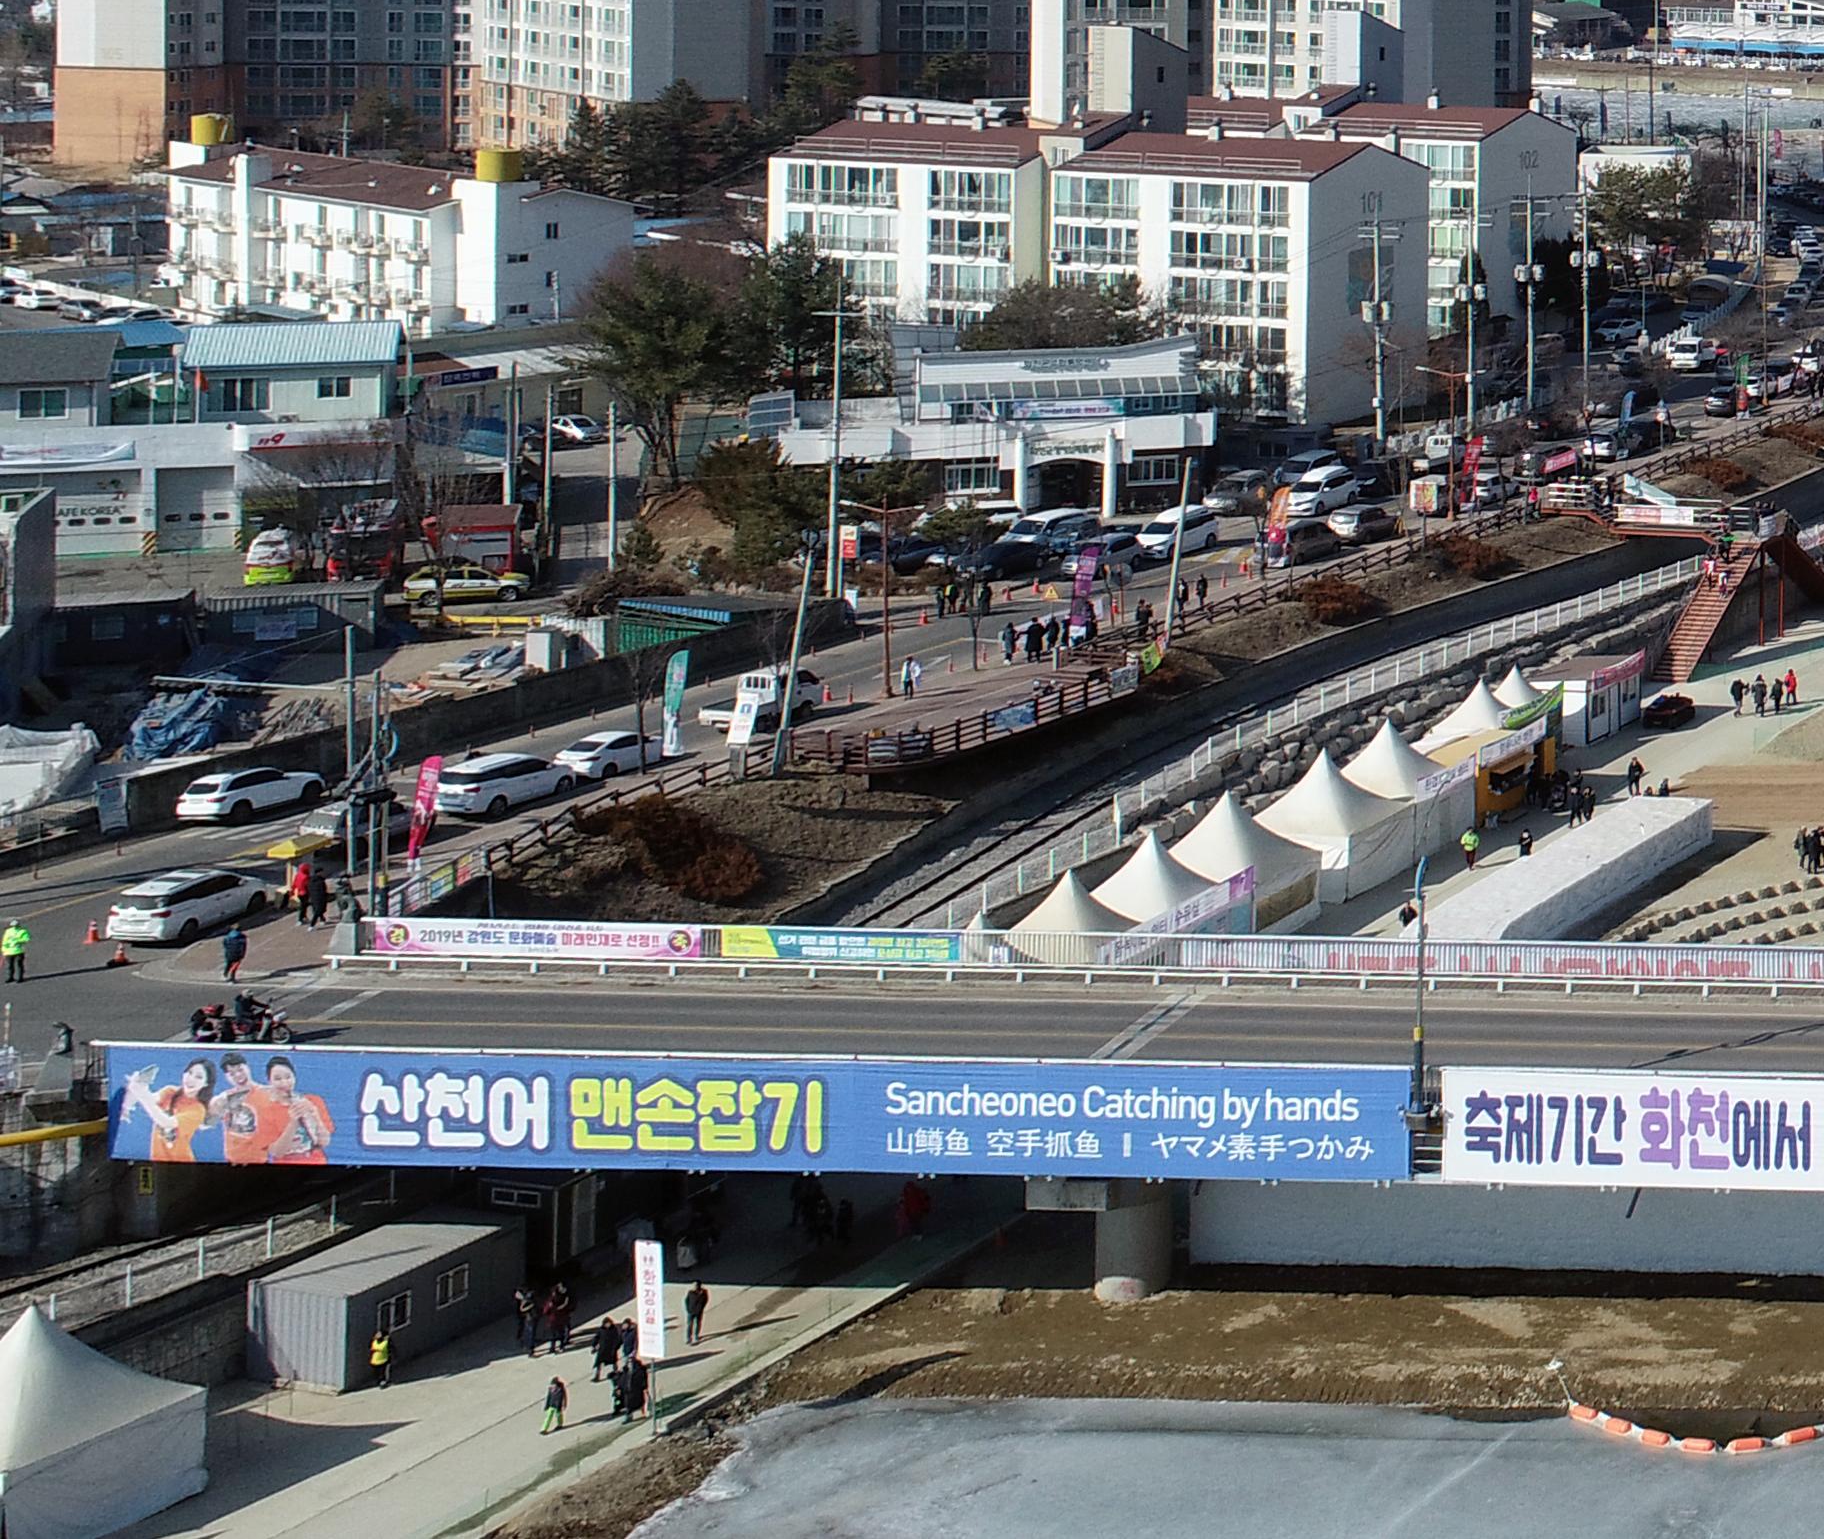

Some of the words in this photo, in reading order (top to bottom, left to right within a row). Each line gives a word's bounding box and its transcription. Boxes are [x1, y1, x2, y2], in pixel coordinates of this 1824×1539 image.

[1519, 150, 1539, 170] 102
[1360, 191, 1383, 214] 101
[419, 930, 464, 944] 2019년
[360, 1072, 549, 1150] 산천어
[570, 1076, 823, 1153] 맨손잡기
[885, 1082, 1076, 1119] Sancheoneo
[1083, 1085, 1217, 1128] Catching
[1223, 1086, 1259, 1129] by
[1264, 1088, 1360, 1123] hands
[886, 1127, 972, 1159] 山鳟鱼
[986, 1128, 1103, 1159] 空手抓鱼
[1464, 1089, 1627, 1166] 축제기간
[1639, 1086, 1813, 1171] 화천에서
[1152, 1132, 1374, 1162] ヤマメ素手つかみ
[642, 1269, 657, 1325] 화장실
